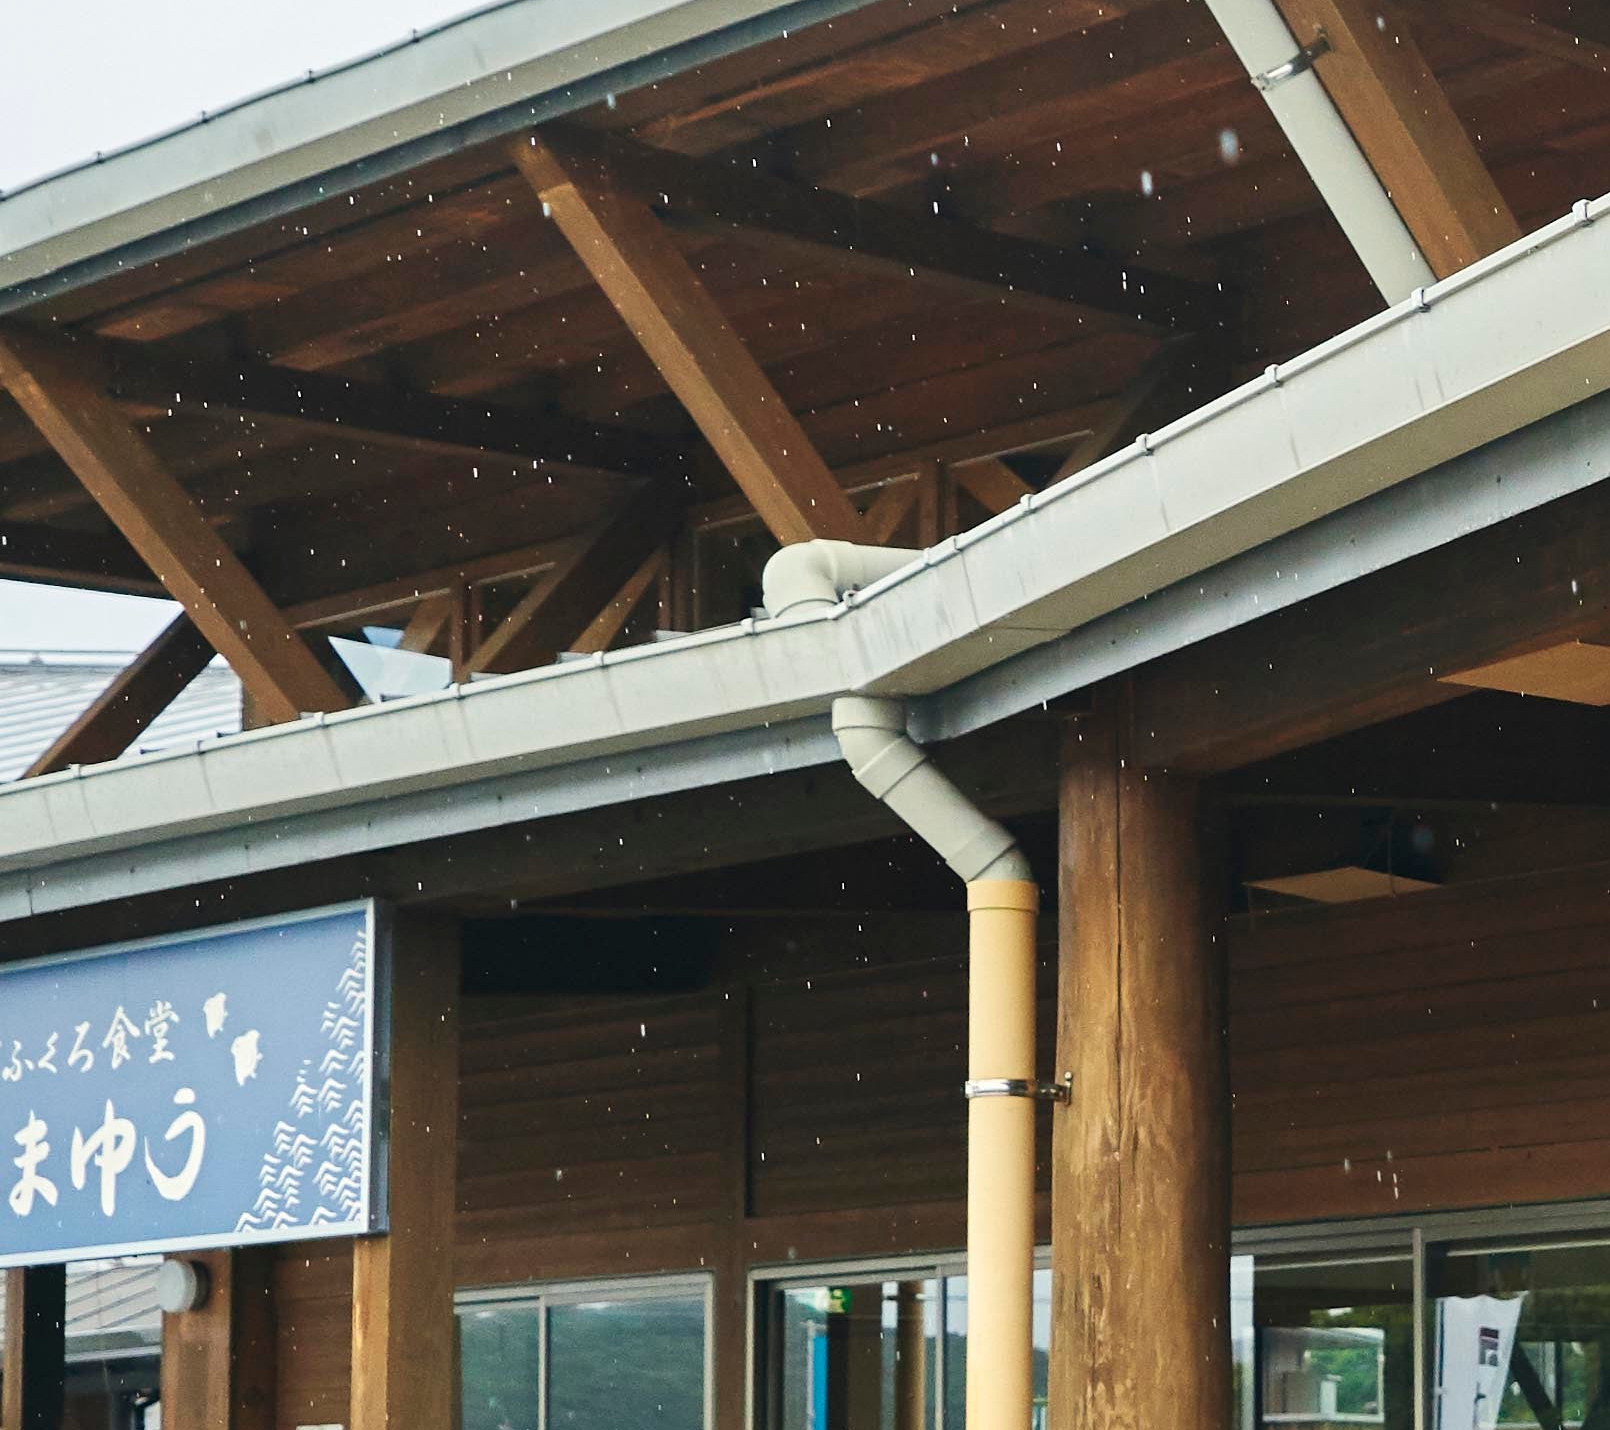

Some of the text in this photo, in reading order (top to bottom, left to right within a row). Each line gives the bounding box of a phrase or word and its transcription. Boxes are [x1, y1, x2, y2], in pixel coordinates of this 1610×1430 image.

[0, 999, 180, 1082] ふくろ食堂
